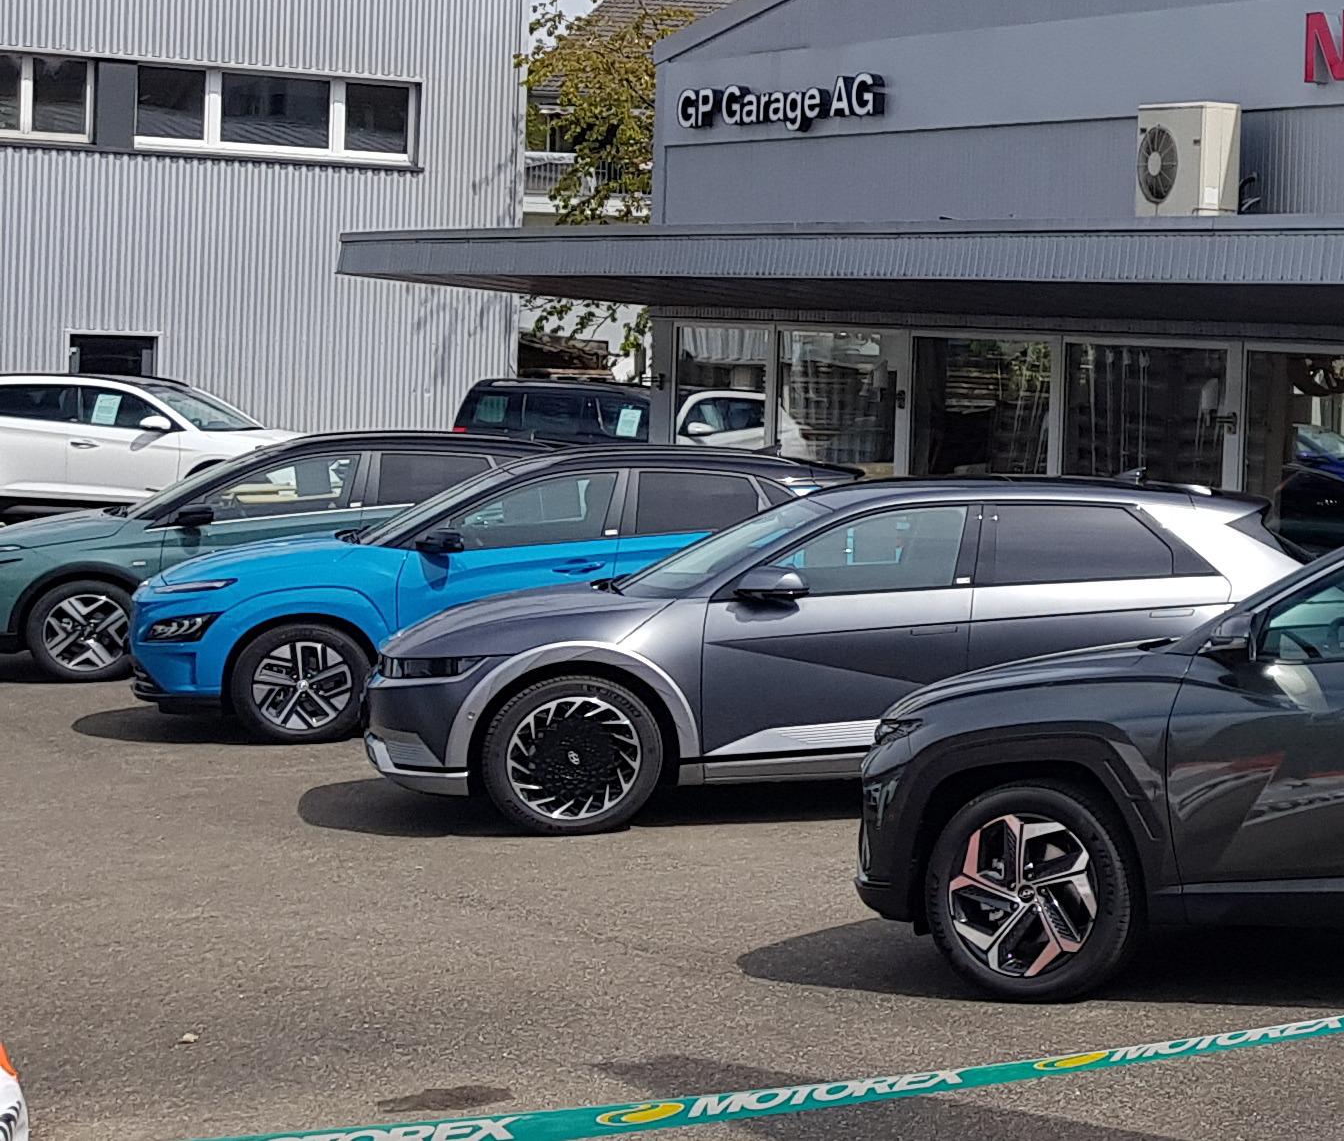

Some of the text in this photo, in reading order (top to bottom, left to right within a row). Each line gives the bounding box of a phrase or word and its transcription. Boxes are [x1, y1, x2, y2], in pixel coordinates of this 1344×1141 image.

[677, 72, 874, 131] GP Garage AG
[688, 1068, 969, 1118] MOTOREX
